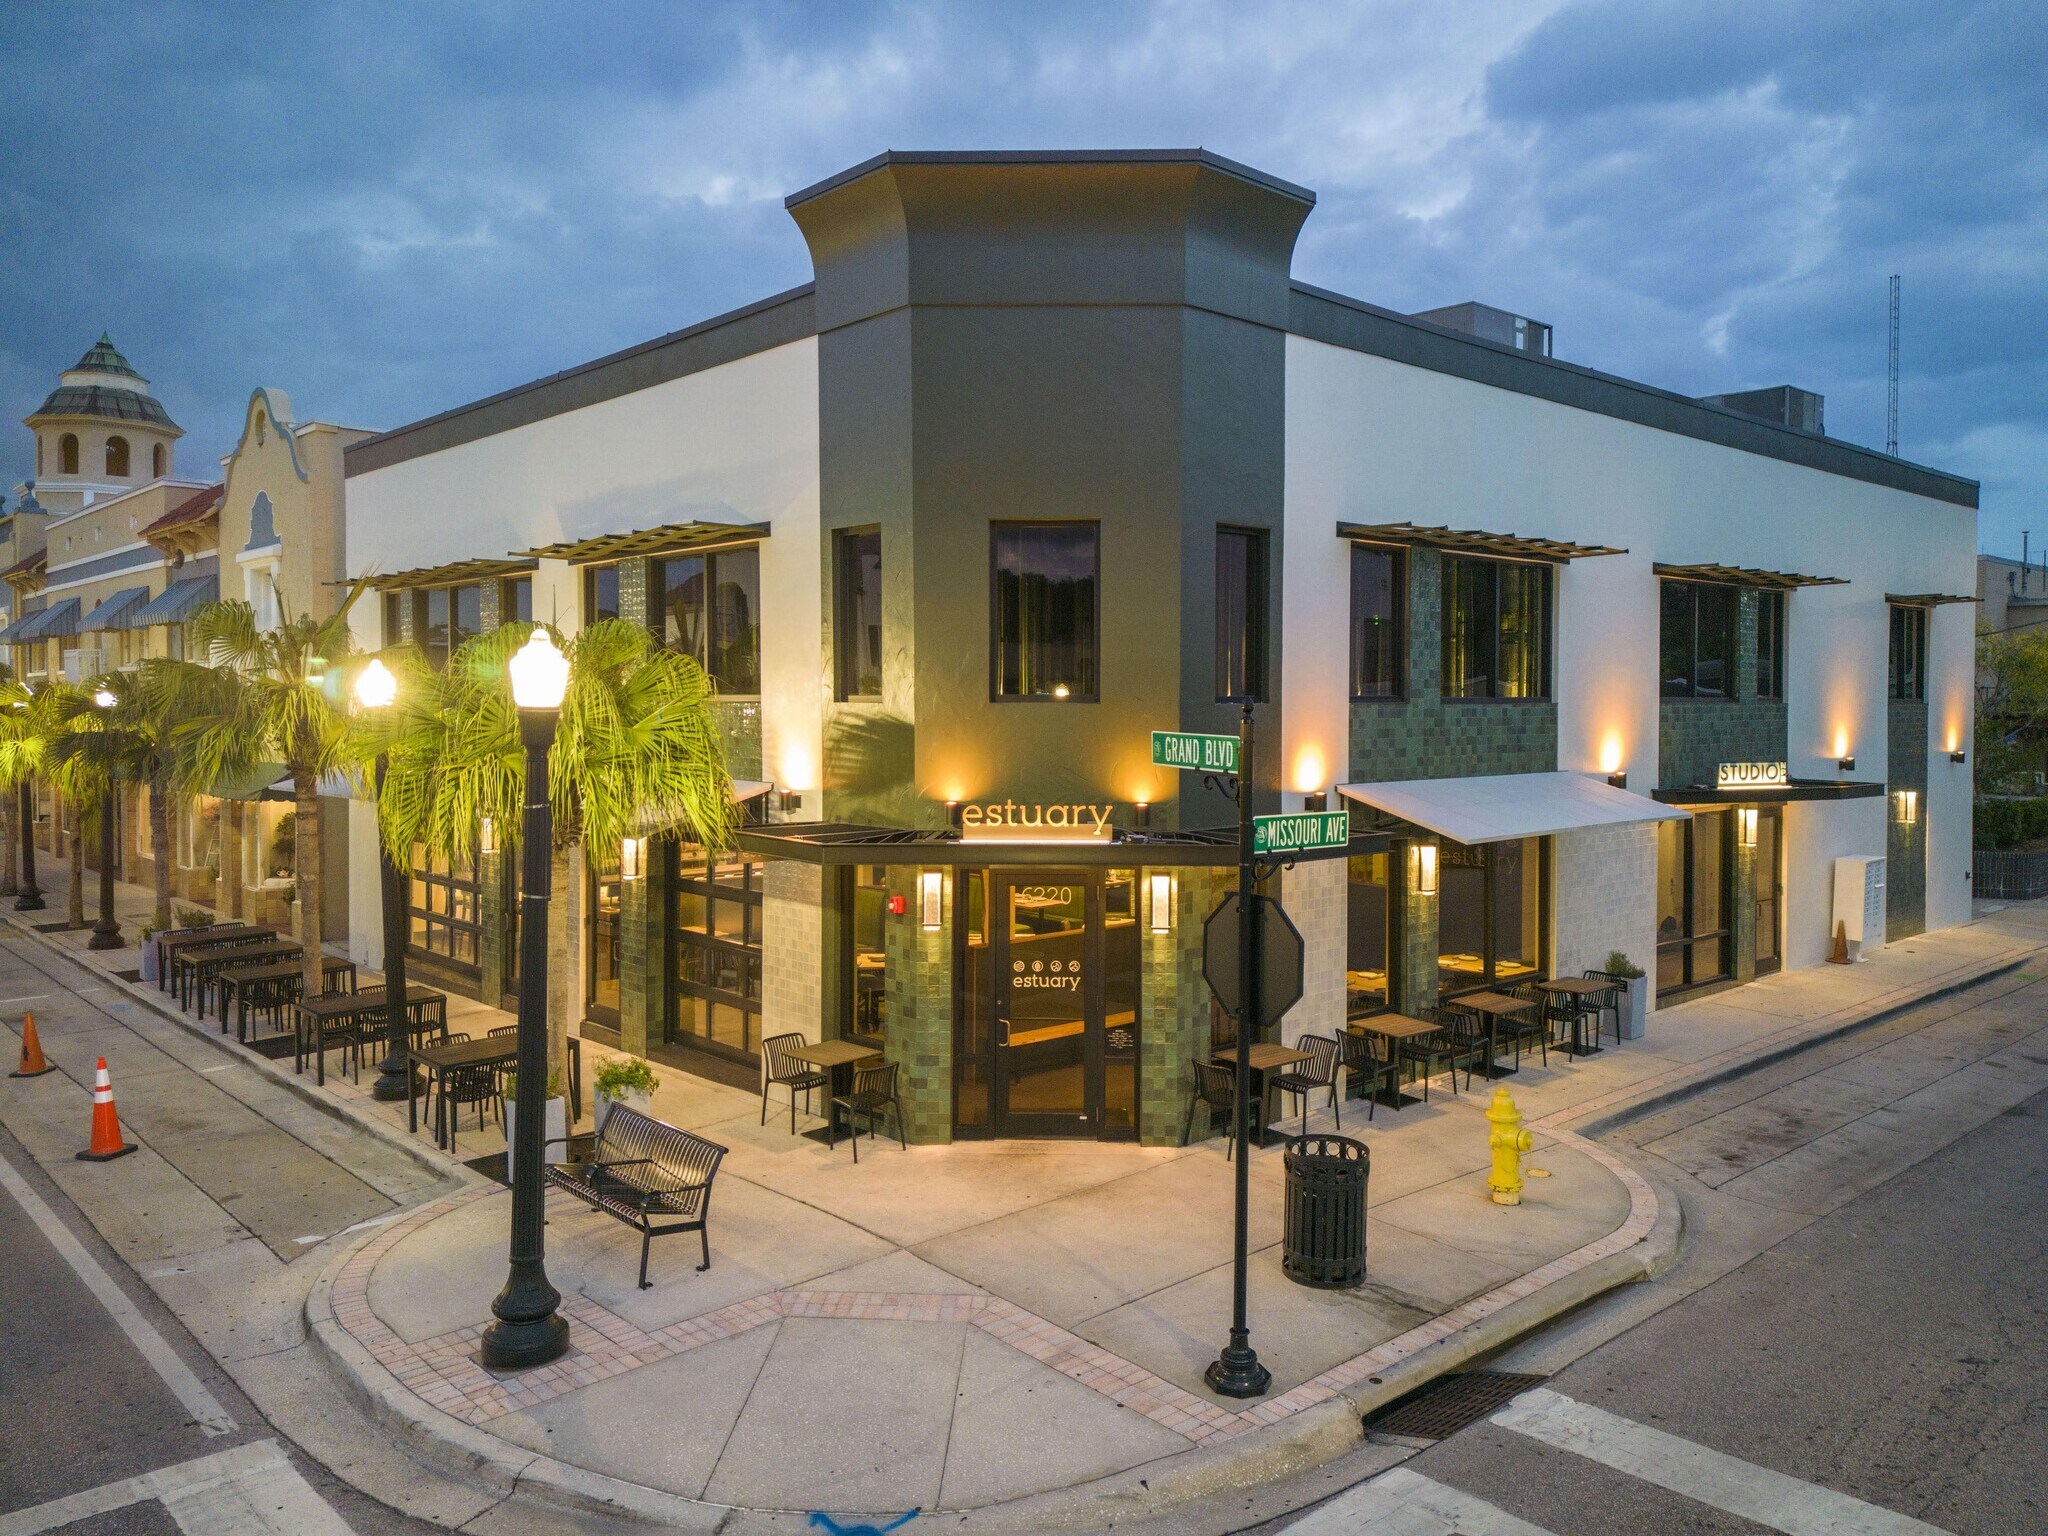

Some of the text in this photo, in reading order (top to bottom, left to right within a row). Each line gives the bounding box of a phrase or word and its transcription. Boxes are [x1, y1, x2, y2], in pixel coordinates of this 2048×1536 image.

[1165, 736, 1234, 768] GRAND BLVD
[1720, 764, 1779, 781] STUDIO
[962, 799, 1113, 836] estuary
[1267, 816, 1346, 848] MISSOURI AVE
[1440, 847, 1519, 875] estury
[1021, 886, 1072, 905] 6220
[1012, 973, 1081, 992] estuary
